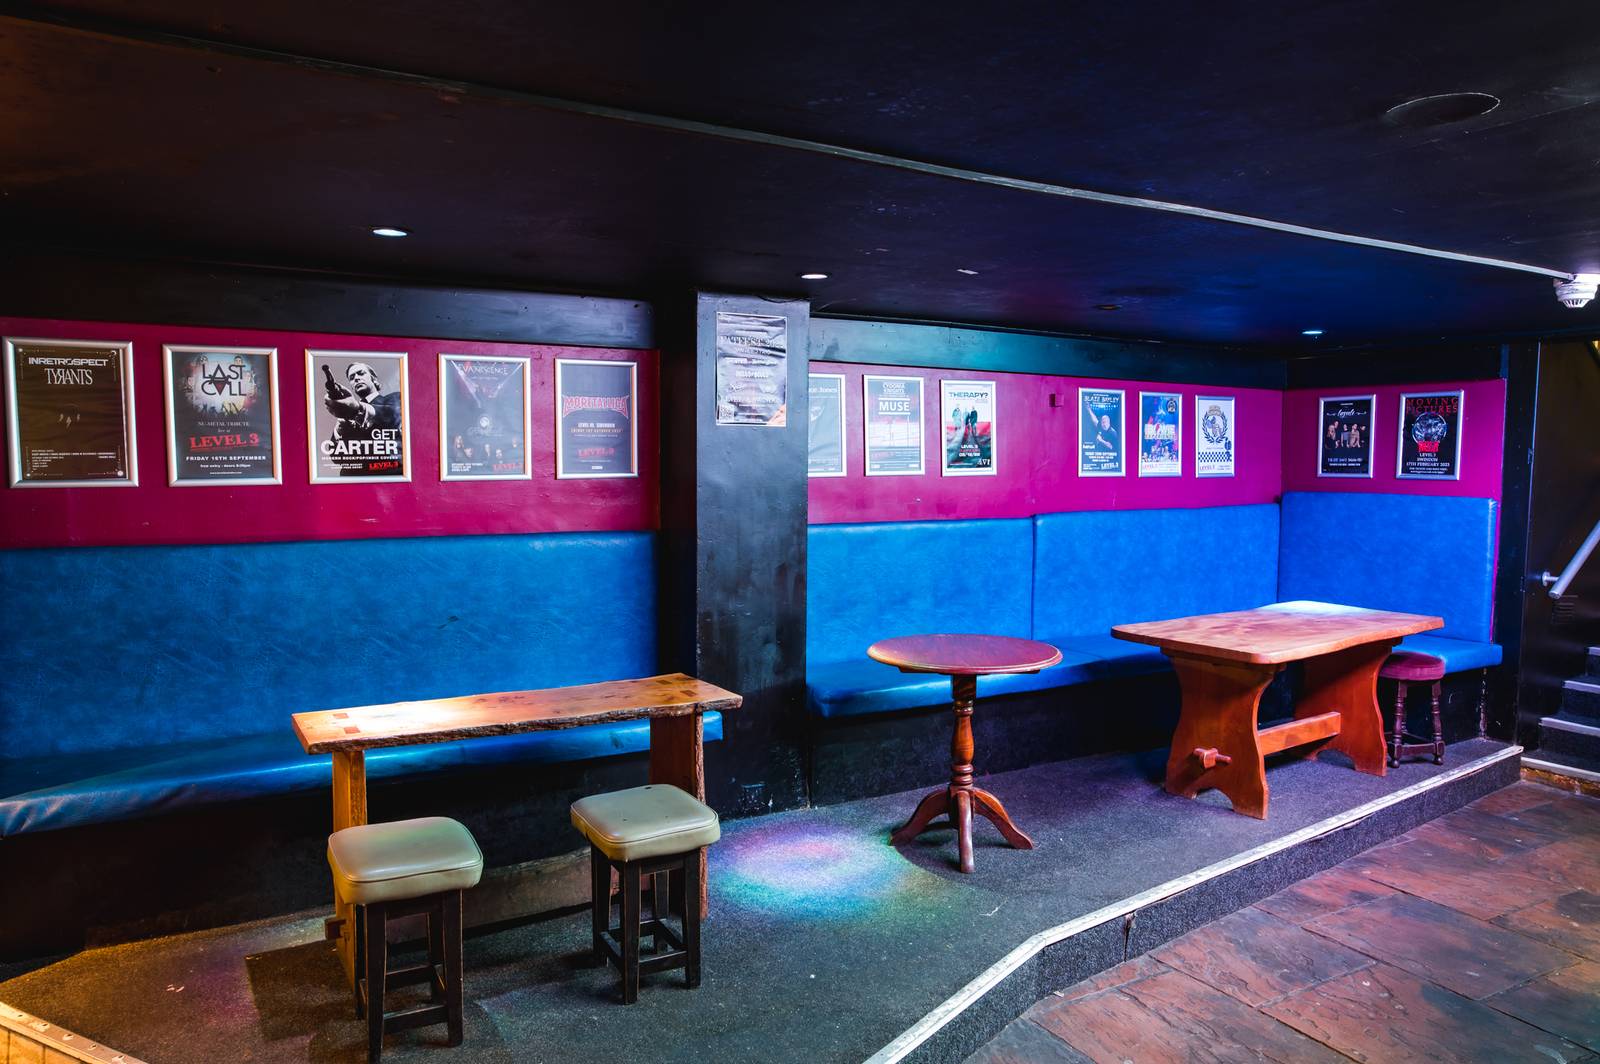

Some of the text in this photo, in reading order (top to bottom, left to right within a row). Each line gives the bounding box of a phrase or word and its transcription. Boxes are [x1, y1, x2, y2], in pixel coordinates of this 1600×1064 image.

[28, 356, 109, 367] INRETROSPECT
[44, 368, 94, 385] TYRANTS
[202, 363, 247, 380] LAST
[948, 391, 989, 399] THERAPY?
[879, 401, 910, 412] MUSE
[1406, 397, 1458, 406] MOVING
[1406, 405, 1458, 414] PICTURES
[371, 428, 398, 440] GET
[190, 432, 260, 450] LEVEL 3
[320, 439, 398, 455] CARTER
